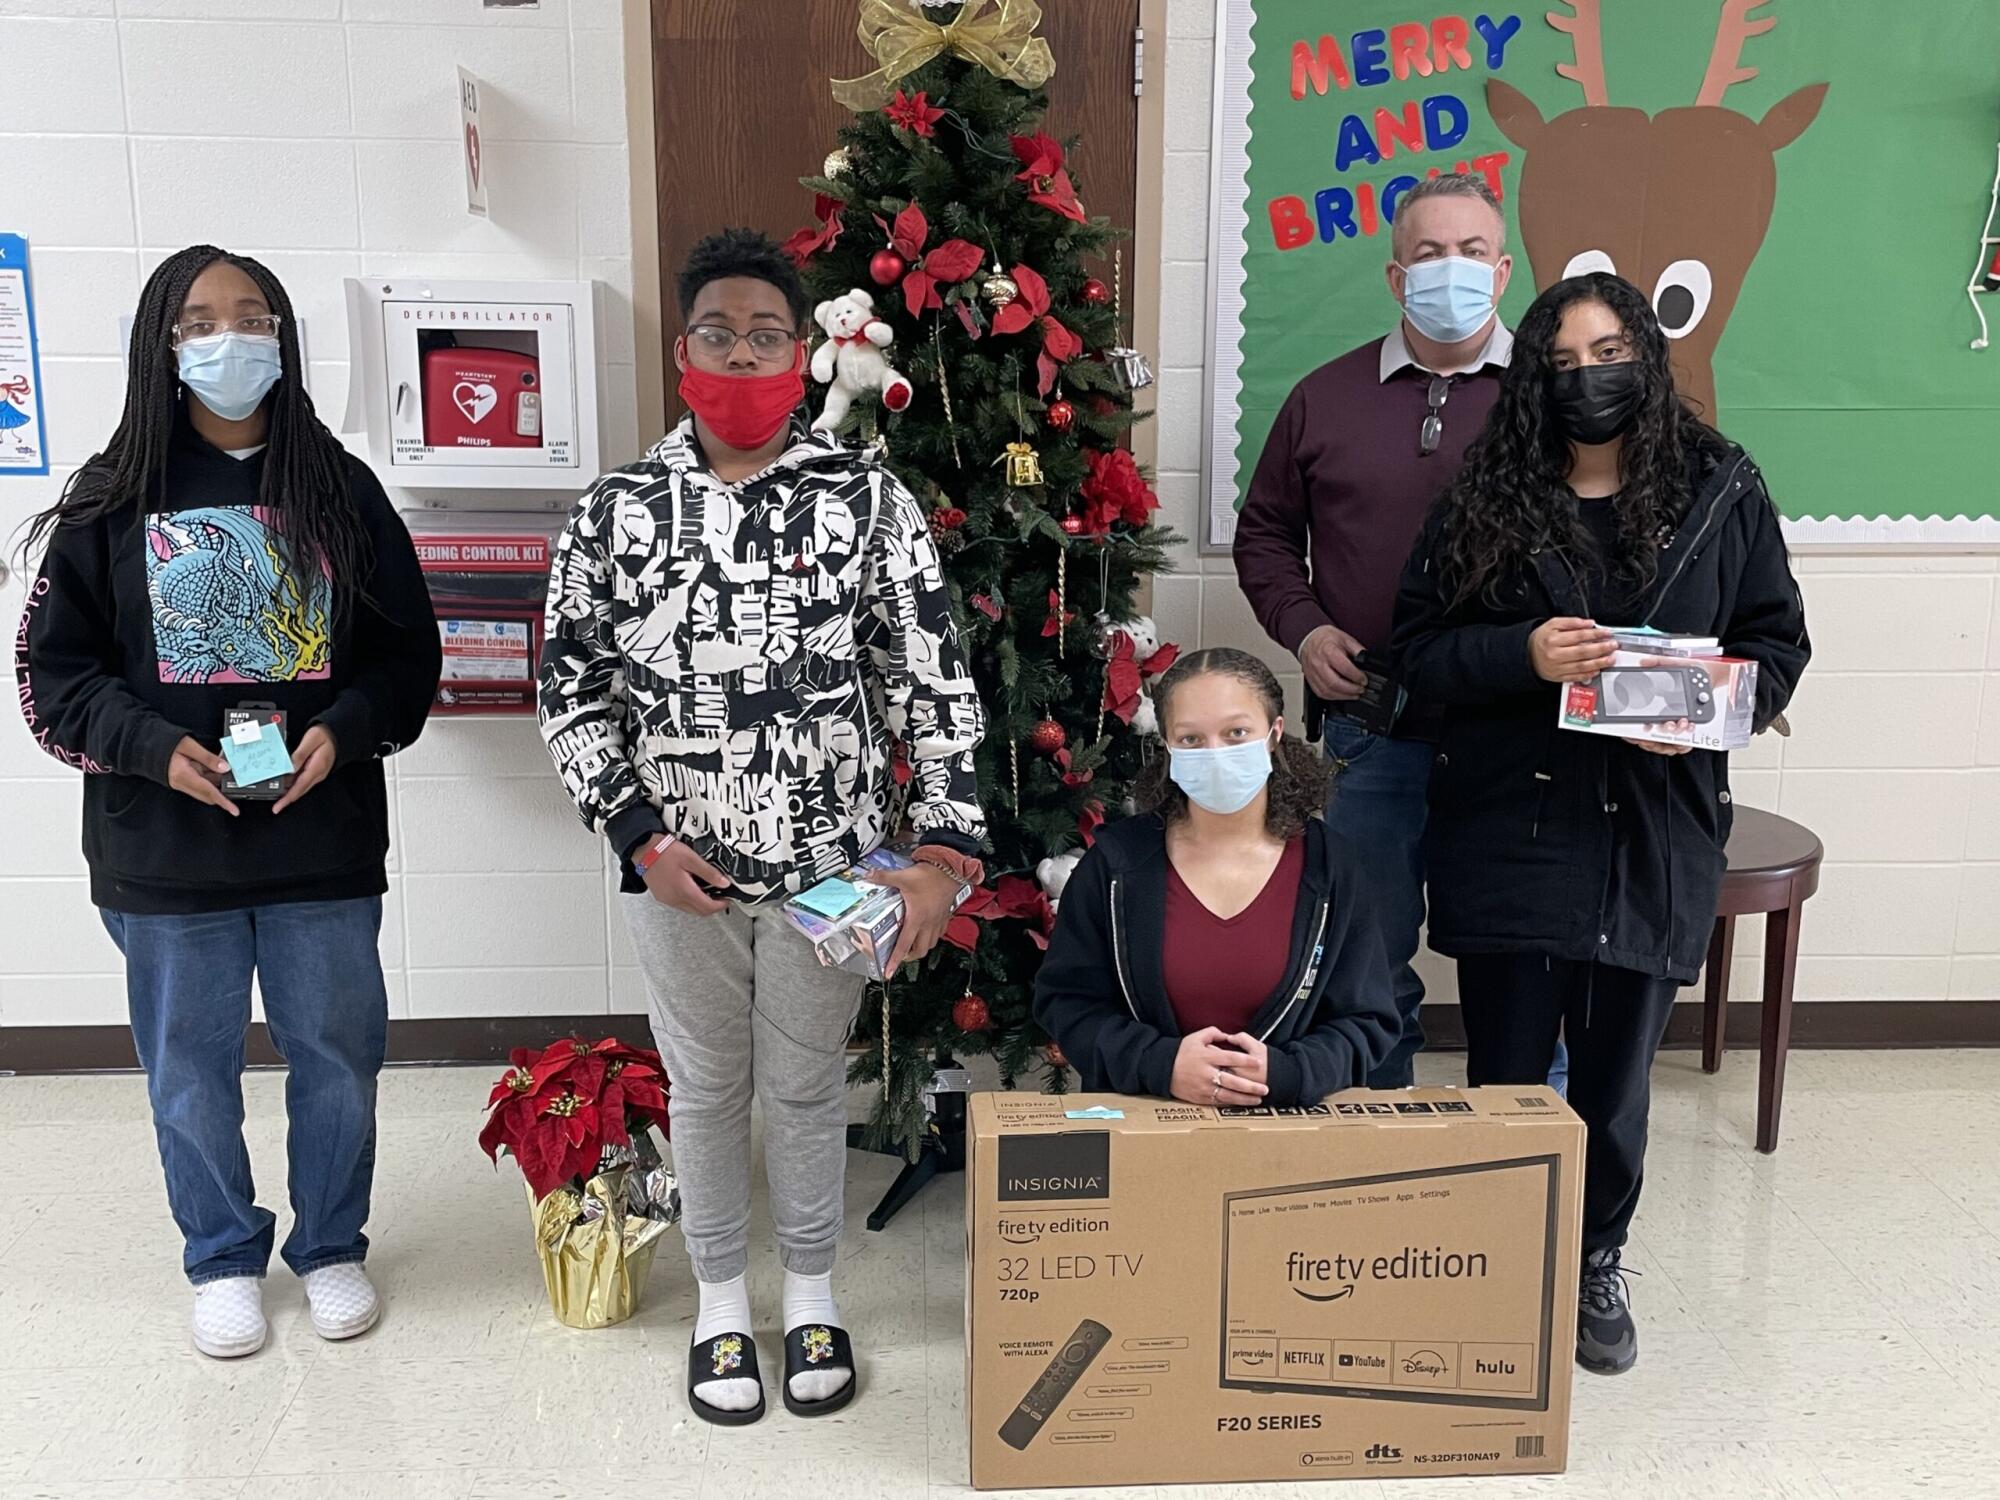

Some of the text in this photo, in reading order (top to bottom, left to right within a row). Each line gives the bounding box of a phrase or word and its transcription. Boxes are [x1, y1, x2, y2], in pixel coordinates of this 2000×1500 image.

[1290, 14, 1521, 100] MERRY
[462, 78, 477, 113] AED
[1335, 95, 1469, 172] AND
[1268, 152, 1509, 250] BRIT
[403, 310, 553, 322] DEFIBRILLATOR
[457, 436, 491, 447] PHILIPS
[415, 545, 544, 561] EEDING CONTROL KIT
[445, 636, 526, 648] BLEEDING CONTROL
[1691, 732, 1720, 747] Lite
[1008, 1177, 1099, 1191] INSIGNIA
[1258, 1206, 1271, 1214] Live
[1274, 1205, 1287, 1213] Your
[1313, 1201, 1327, 1209] Free
[1330, 1198, 1352, 1207] Movies
[1357, 1196, 1367, 1205] TV
[1367, 1195, 1390, 1204] Shows
[1396, 1192, 1414, 1203] Apps
[1419, 1189, 1451, 1199] Settings
[1050, 1218, 1109, 1233] edition
[997, 1253, 1144, 1282] 32 LED TV
[1371, 1247, 1487, 1280] edition
[999, 1288, 1040, 1303] 720p
[1003, 1349, 1049, 1358] WITH ALEXA
[1232, 1349, 1274, 1359] prime video
[1284, 1351, 1324, 1366] NETFLIX
[1354, 1355, 1386, 1368] YouTube
[1475, 1359, 1515, 1375] hulu
[1217, 1414, 1322, 1431] F20 SERIES
[1364, 1443, 1403, 1459] dts
[1414, 1452, 1500, 1463] NS-32DF310NA19
